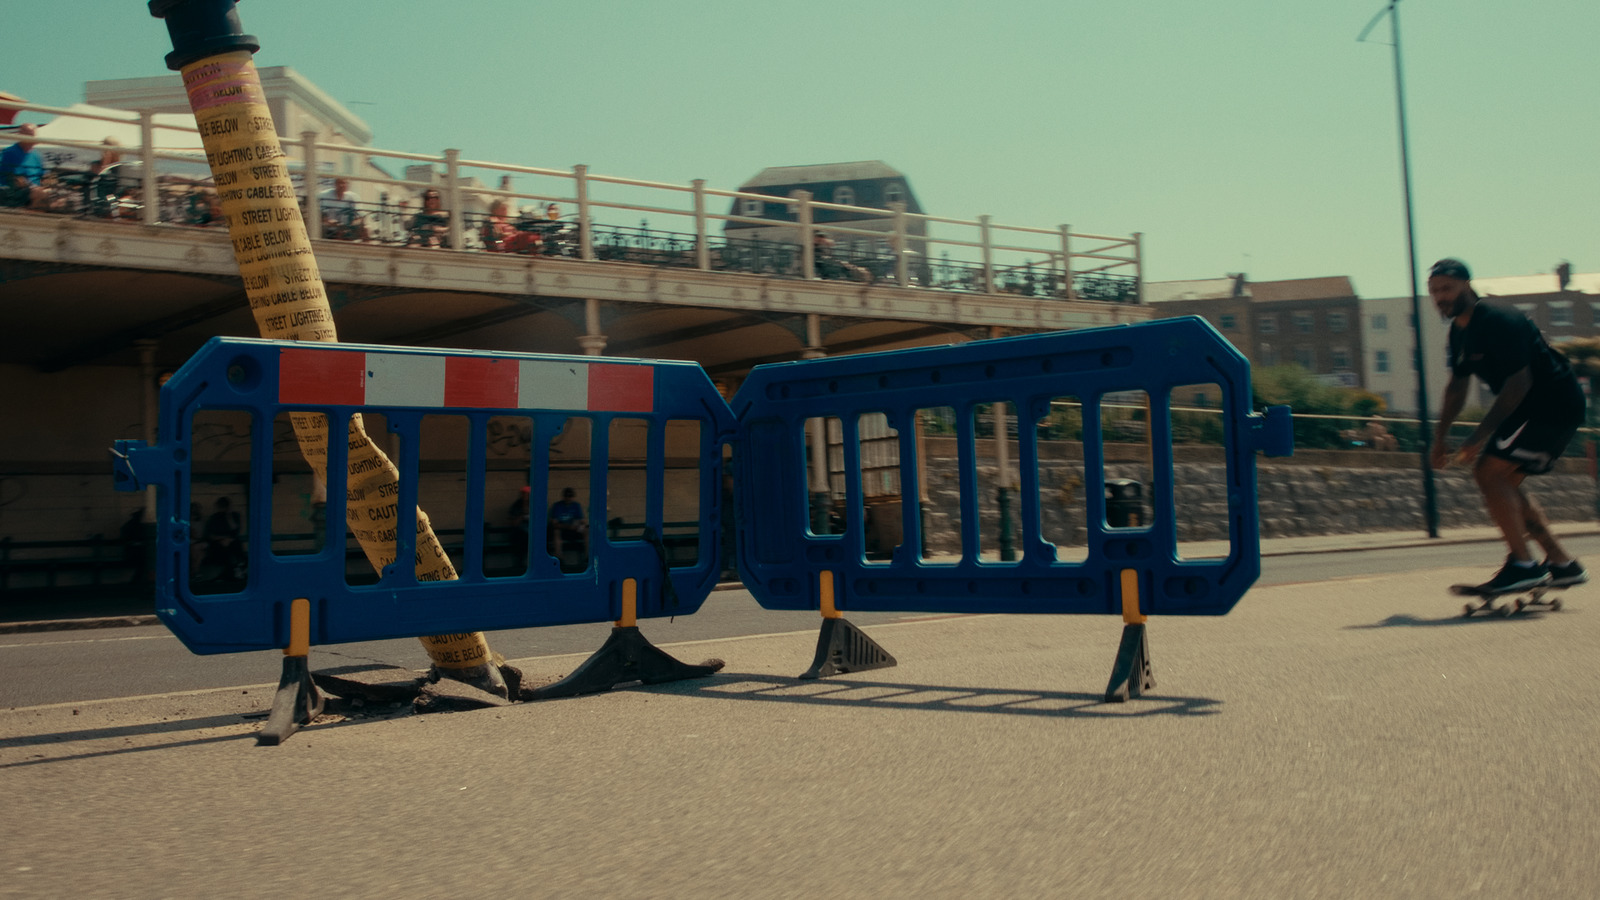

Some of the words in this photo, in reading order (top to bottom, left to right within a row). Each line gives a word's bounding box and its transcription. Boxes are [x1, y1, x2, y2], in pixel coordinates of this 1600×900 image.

[211, 118, 239, 135] BELOW
[216, 147, 253, 167] LIGHTING
[252, 164, 280, 180] STREET
[246, 186, 275, 199] CABLE
[242, 208, 272, 226] STREET
[263, 228, 293, 247] BELOW
[271, 289, 299, 306] CABLE
[290, 309, 324, 327] LIGHTING
[348, 455, 382, 475] LIGHTING
[378, 481, 398, 498] STRE
